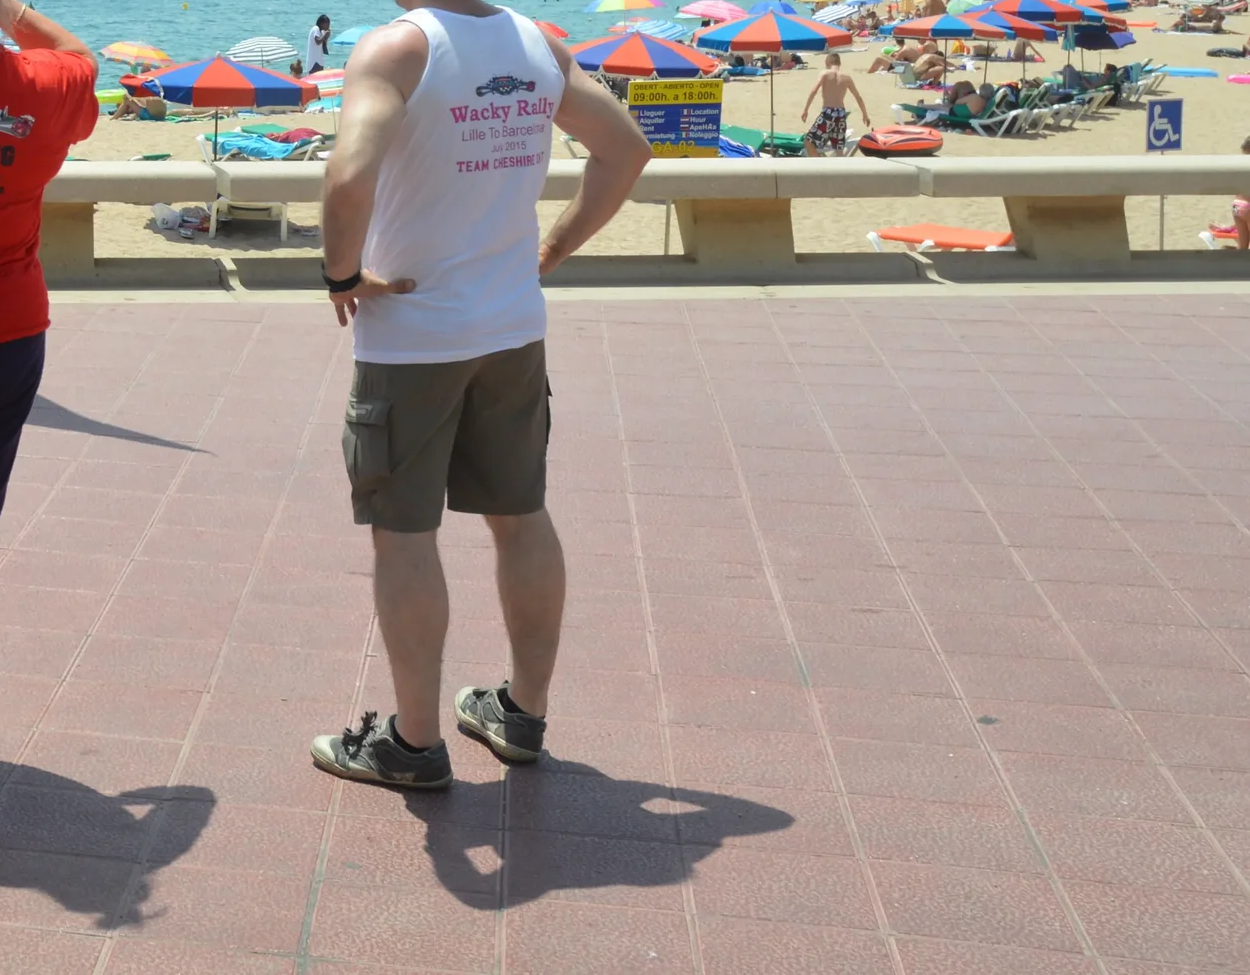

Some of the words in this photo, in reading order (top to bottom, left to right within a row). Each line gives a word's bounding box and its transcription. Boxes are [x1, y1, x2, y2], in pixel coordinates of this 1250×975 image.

[633, 92, 670, 102] 09:00h.
[683, 91, 718, 101] 18:00h.
[450, 102, 512, 123] Wacky
[516, 96, 554, 119] Rally
[461, 128, 486, 142] Lille
[488, 126, 500, 139] To
[505, 140, 527, 151] 2015
[456, 159, 489, 173] TEAM
[493, 154, 535, 170] CHESHIRE
